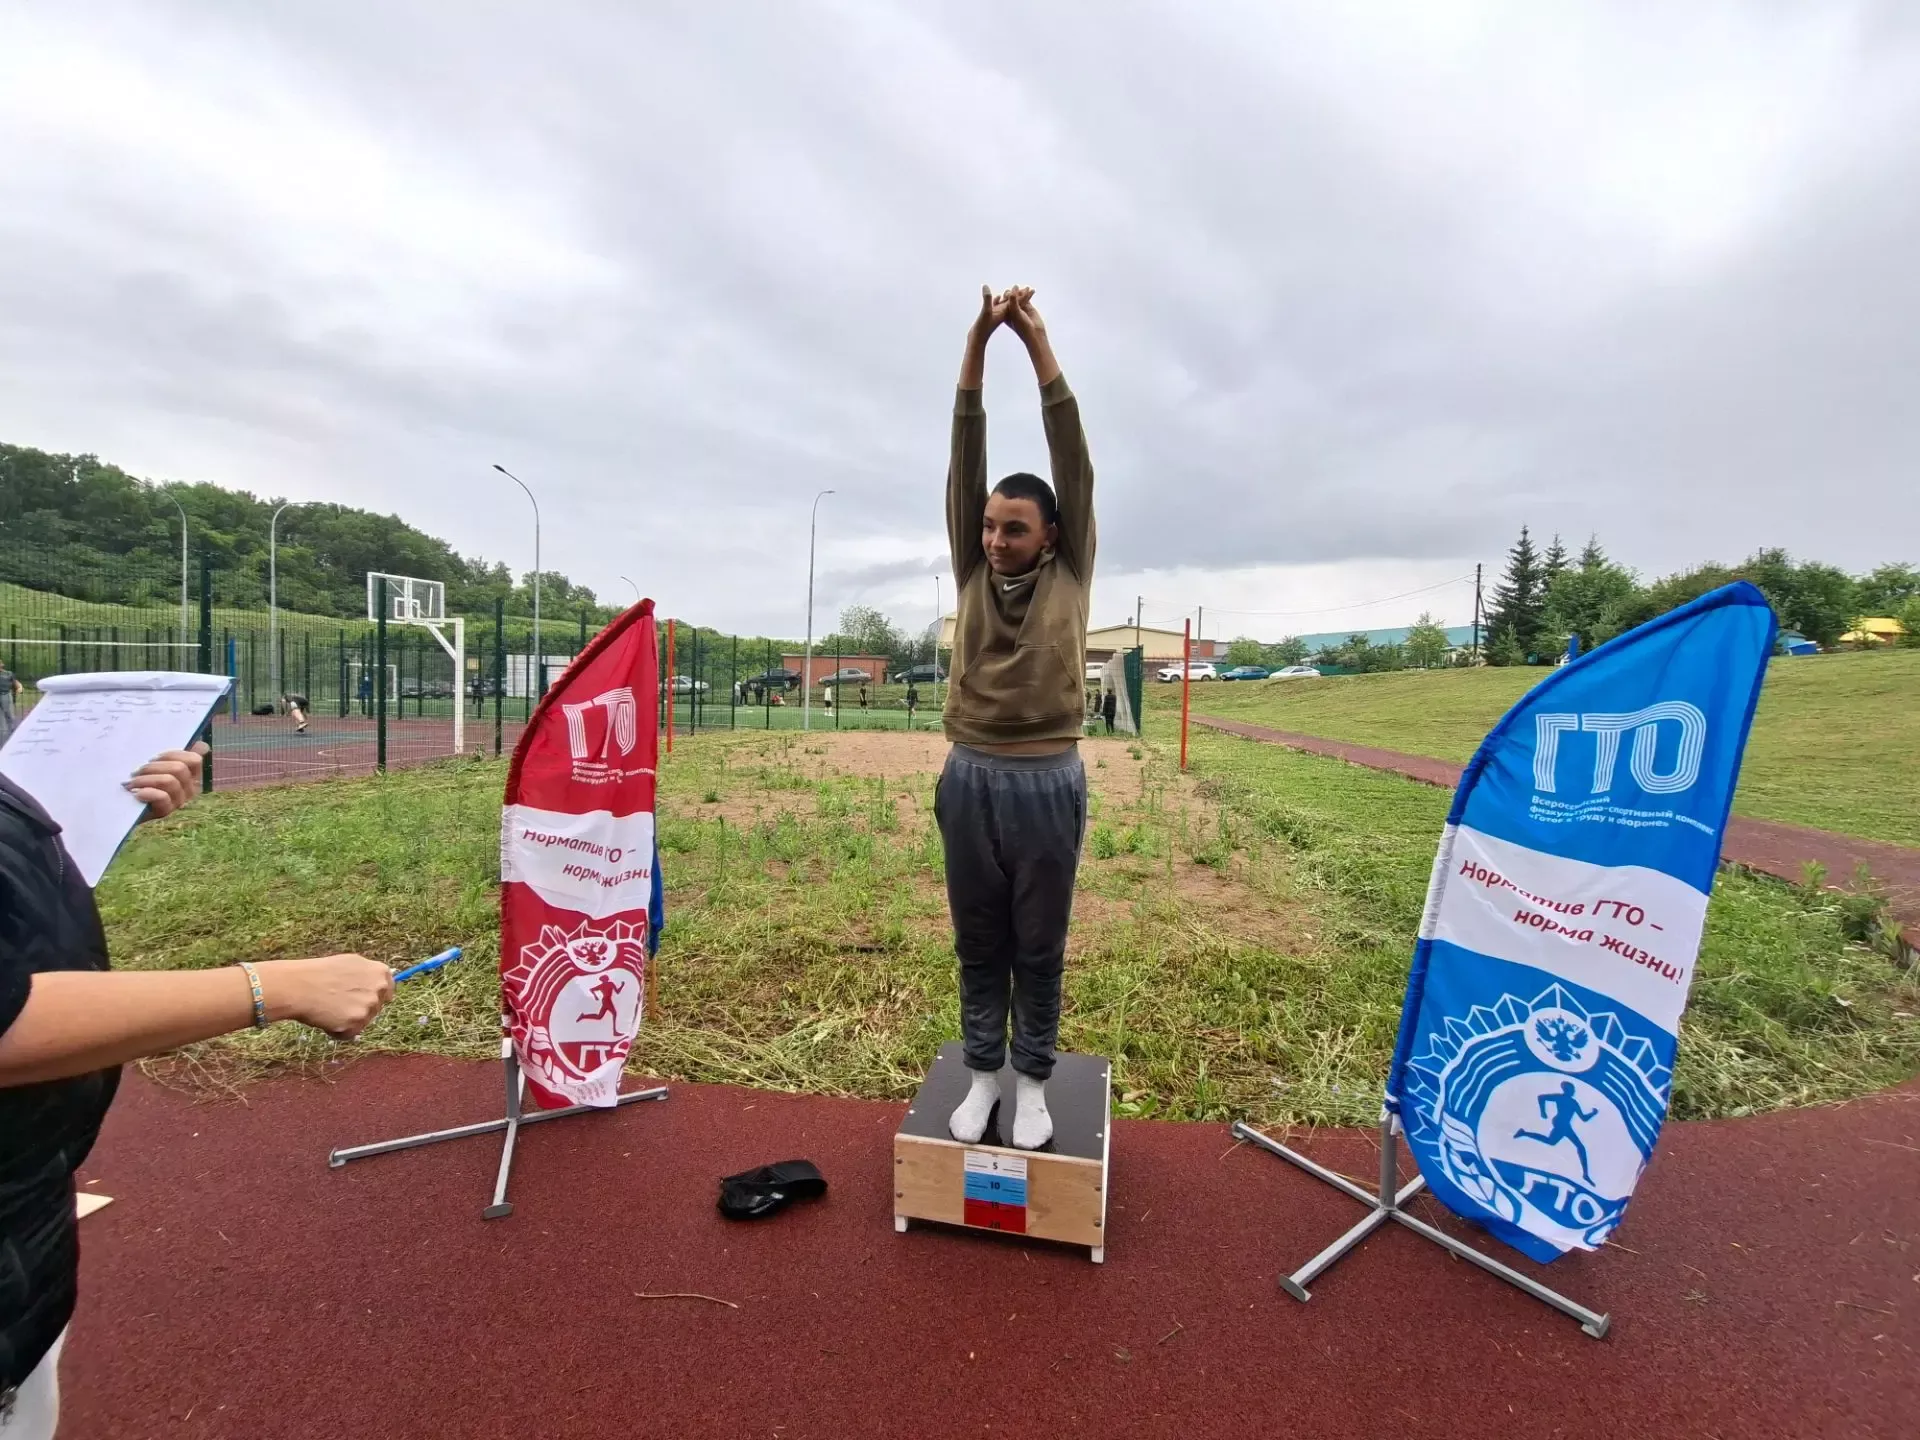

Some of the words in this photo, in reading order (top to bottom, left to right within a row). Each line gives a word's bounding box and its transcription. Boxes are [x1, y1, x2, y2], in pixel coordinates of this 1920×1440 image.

[1532, 700, 1707, 794] ГТО
[1459, 860, 1585, 916] Норматив
[1591, 900, 1645, 927] ГТО
[1513, 910, 1595, 943] норма
[1599, 934, 1684, 985] жизни!
[989, 1181, 1001, 1190] 10
[993, 1162, 999, 1170] 5
[1519, 1171, 1604, 1225] ГТО
